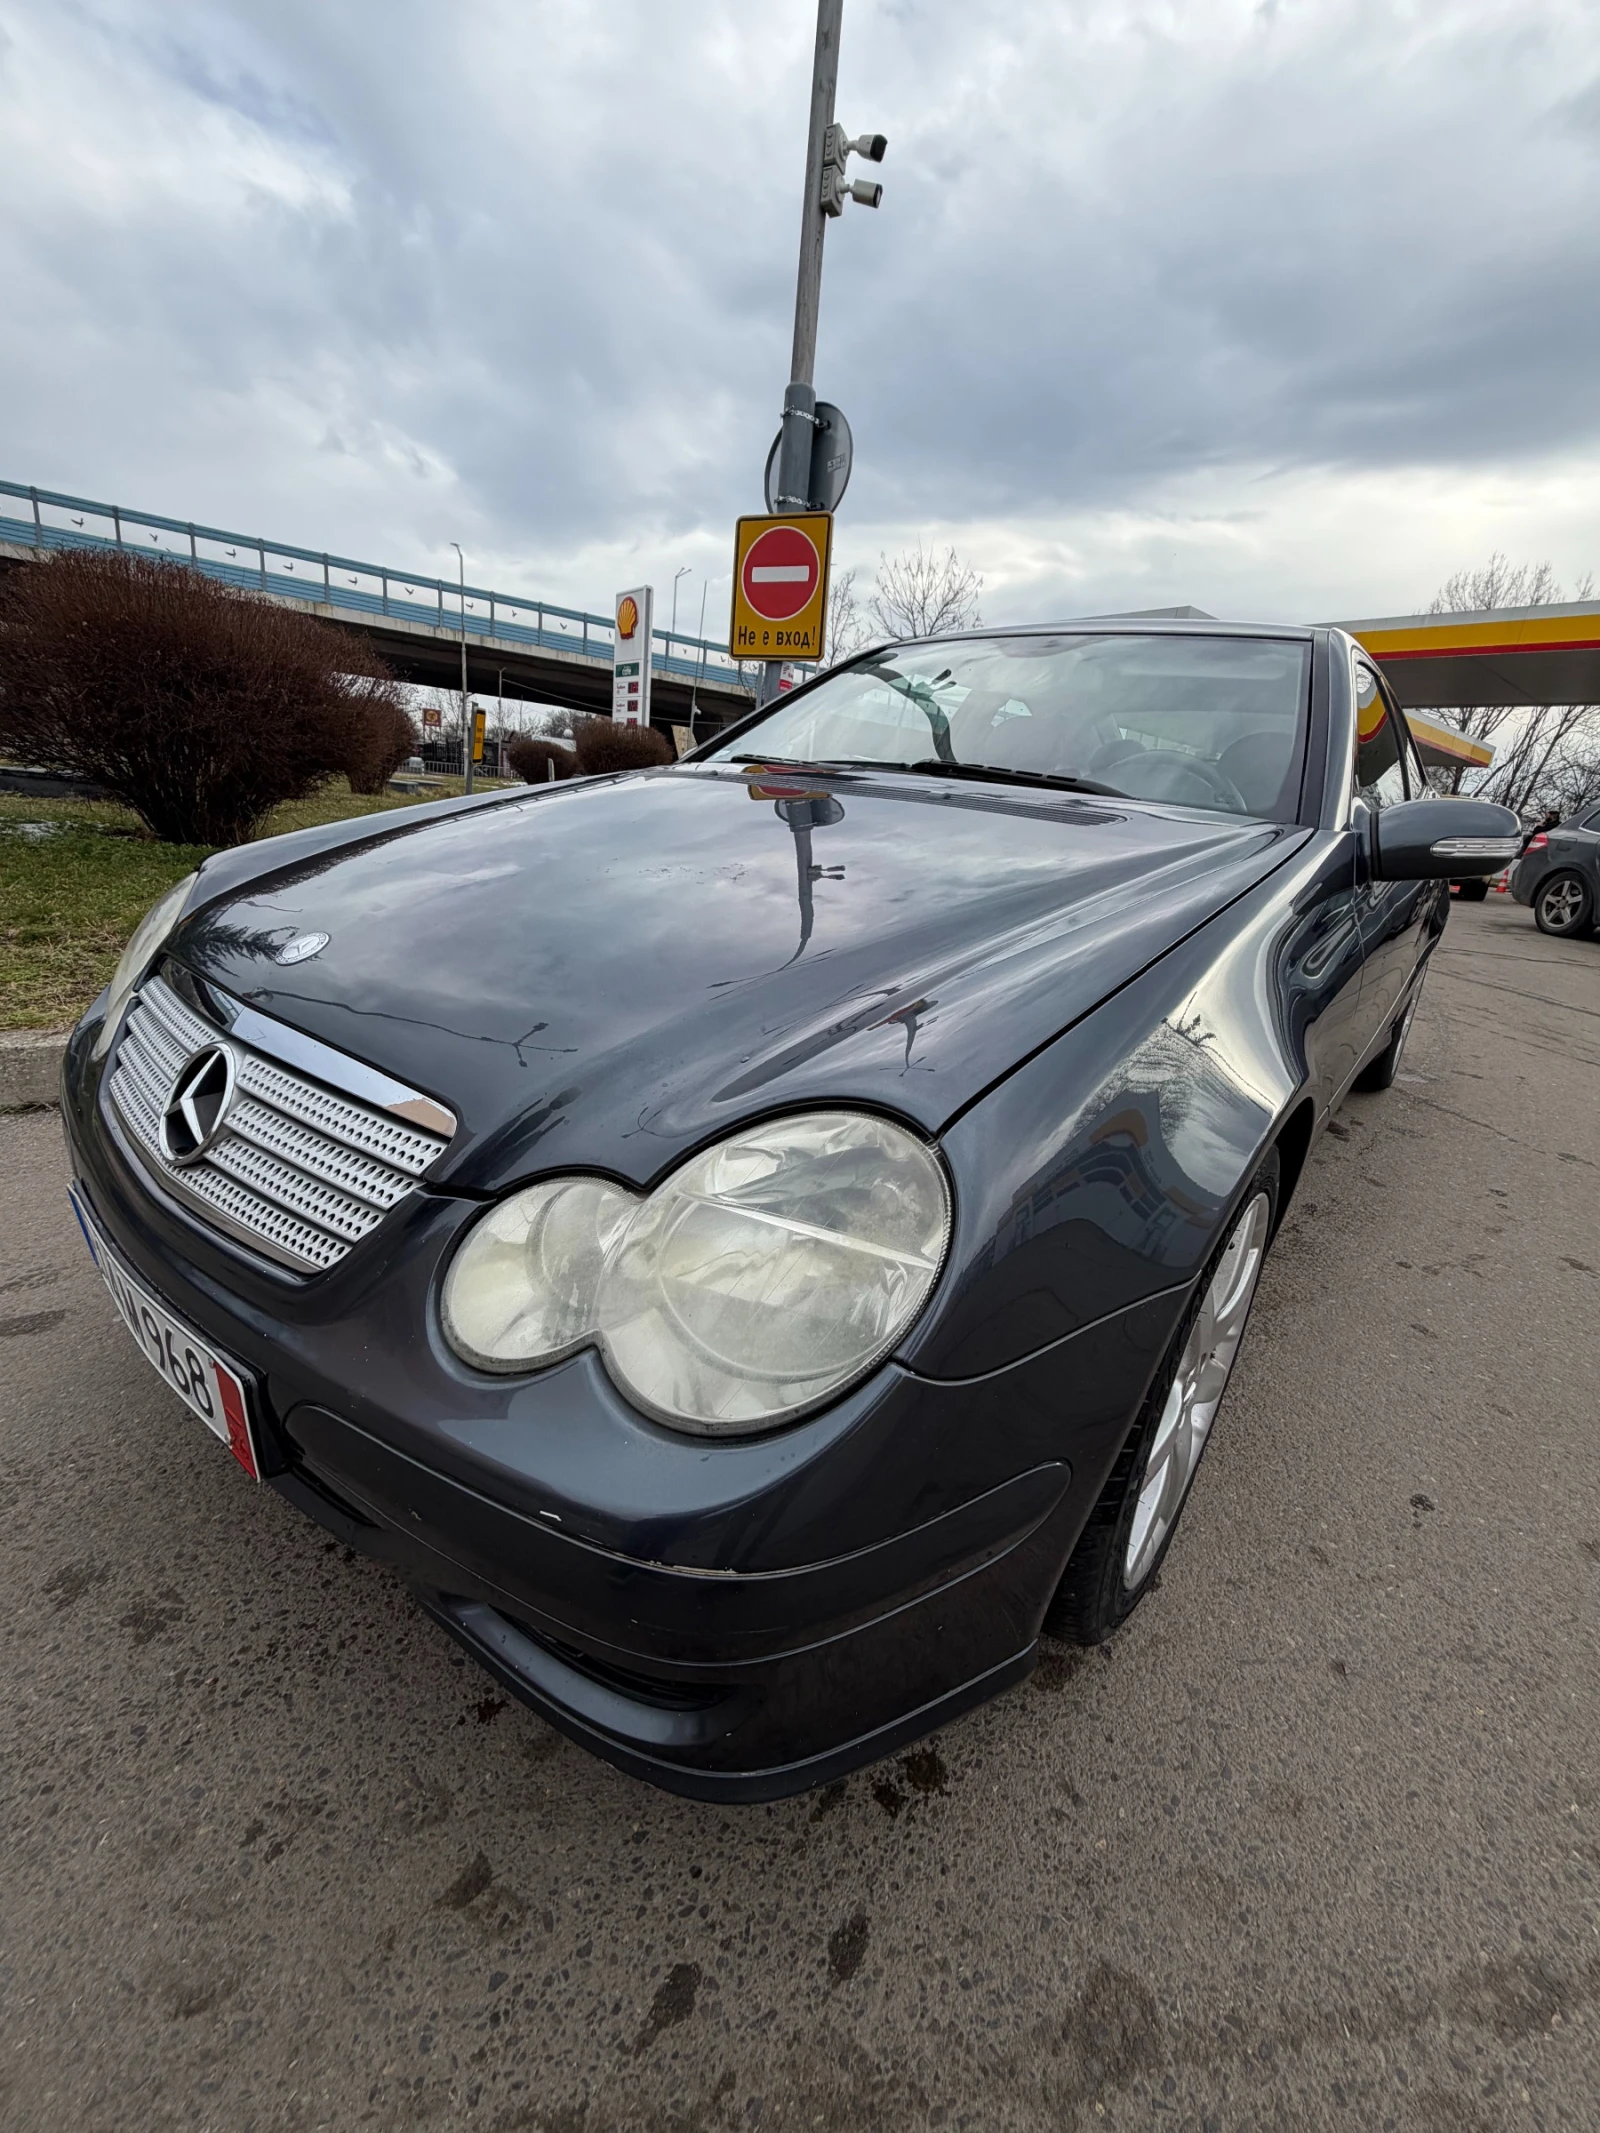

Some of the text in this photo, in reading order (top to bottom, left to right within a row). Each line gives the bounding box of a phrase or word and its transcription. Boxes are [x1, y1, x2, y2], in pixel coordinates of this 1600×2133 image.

[738, 626, 816, 649] Не е вход!
